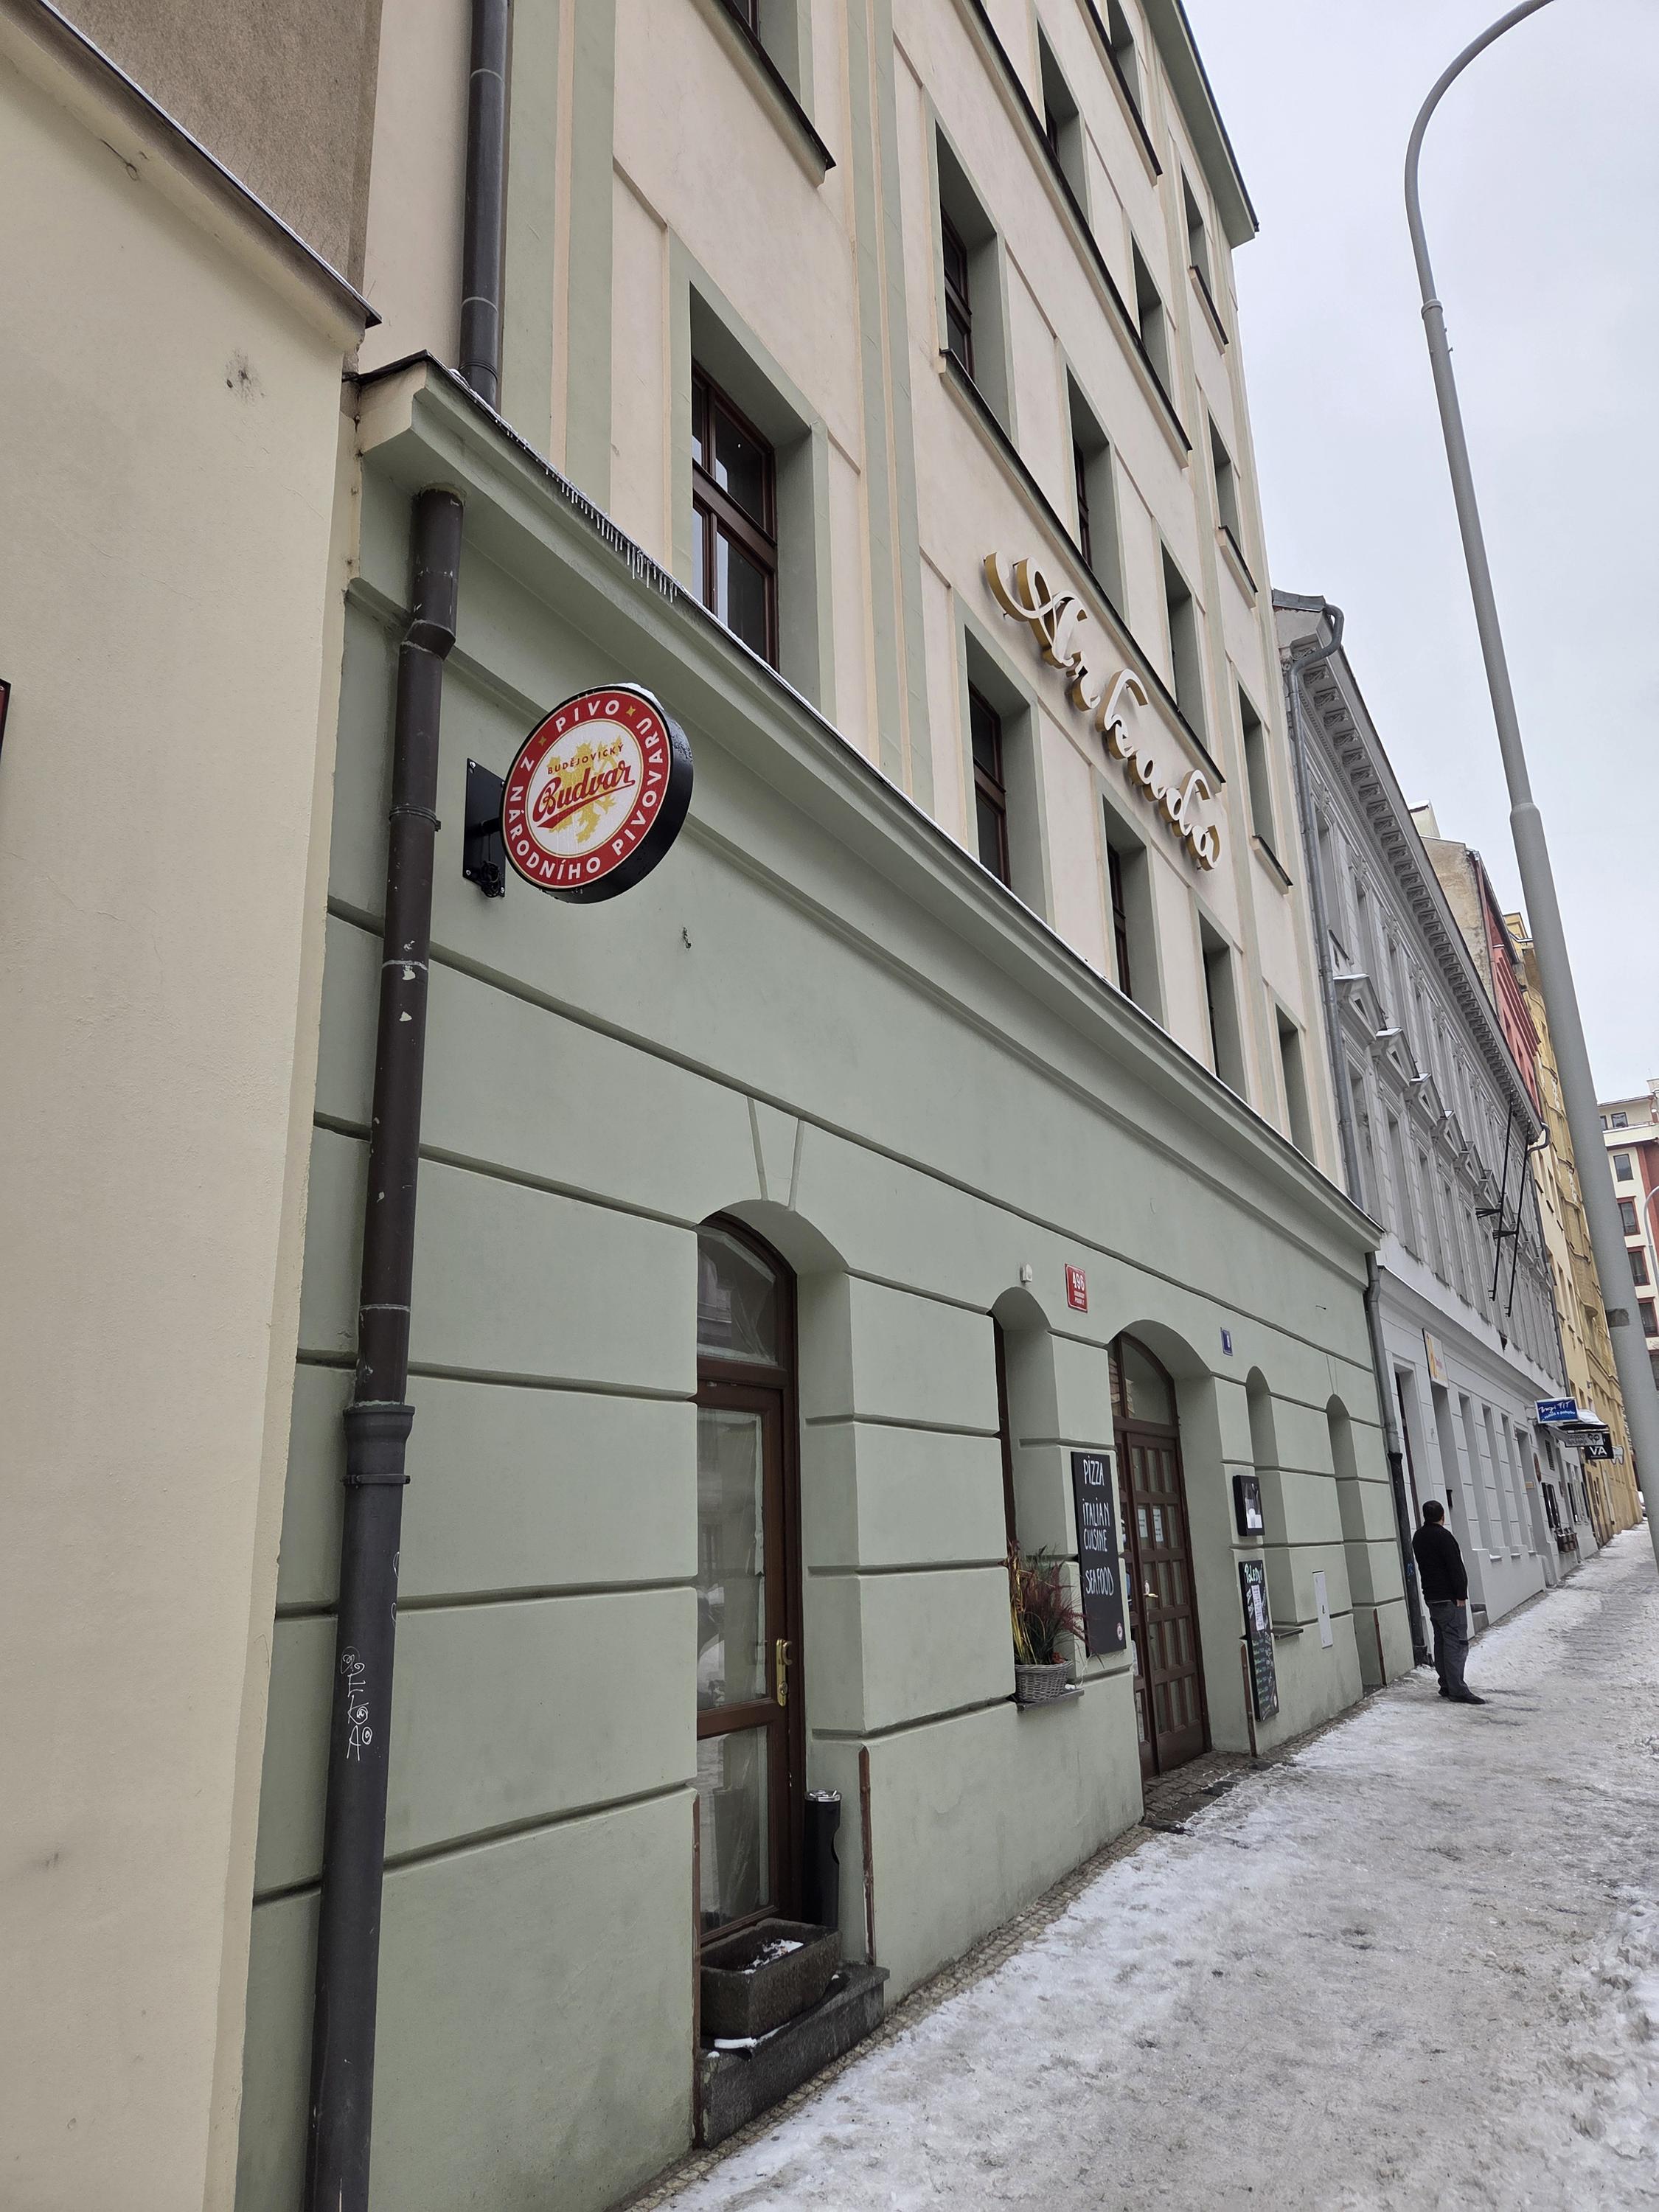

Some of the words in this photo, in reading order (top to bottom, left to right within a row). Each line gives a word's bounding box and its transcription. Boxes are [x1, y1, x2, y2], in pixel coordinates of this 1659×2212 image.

[555, 700, 619, 732] PIVO
[984, 552, 1220, 871] Arkada
[521, 756, 535, 772] Z
[547, 742, 625, 774] BUDĚJOVICKÝ
[532, 760, 636, 829] Budvar
[612, 717, 663, 855] PIVOVARU
[509, 786, 601, 880] NÁRODNÍHO
[1072, 1271, 1085, 1291] 496
[1084, 1528, 1107, 1551] CUISINE
[1085, 1567, 1114, 1596] SEAFOOD
